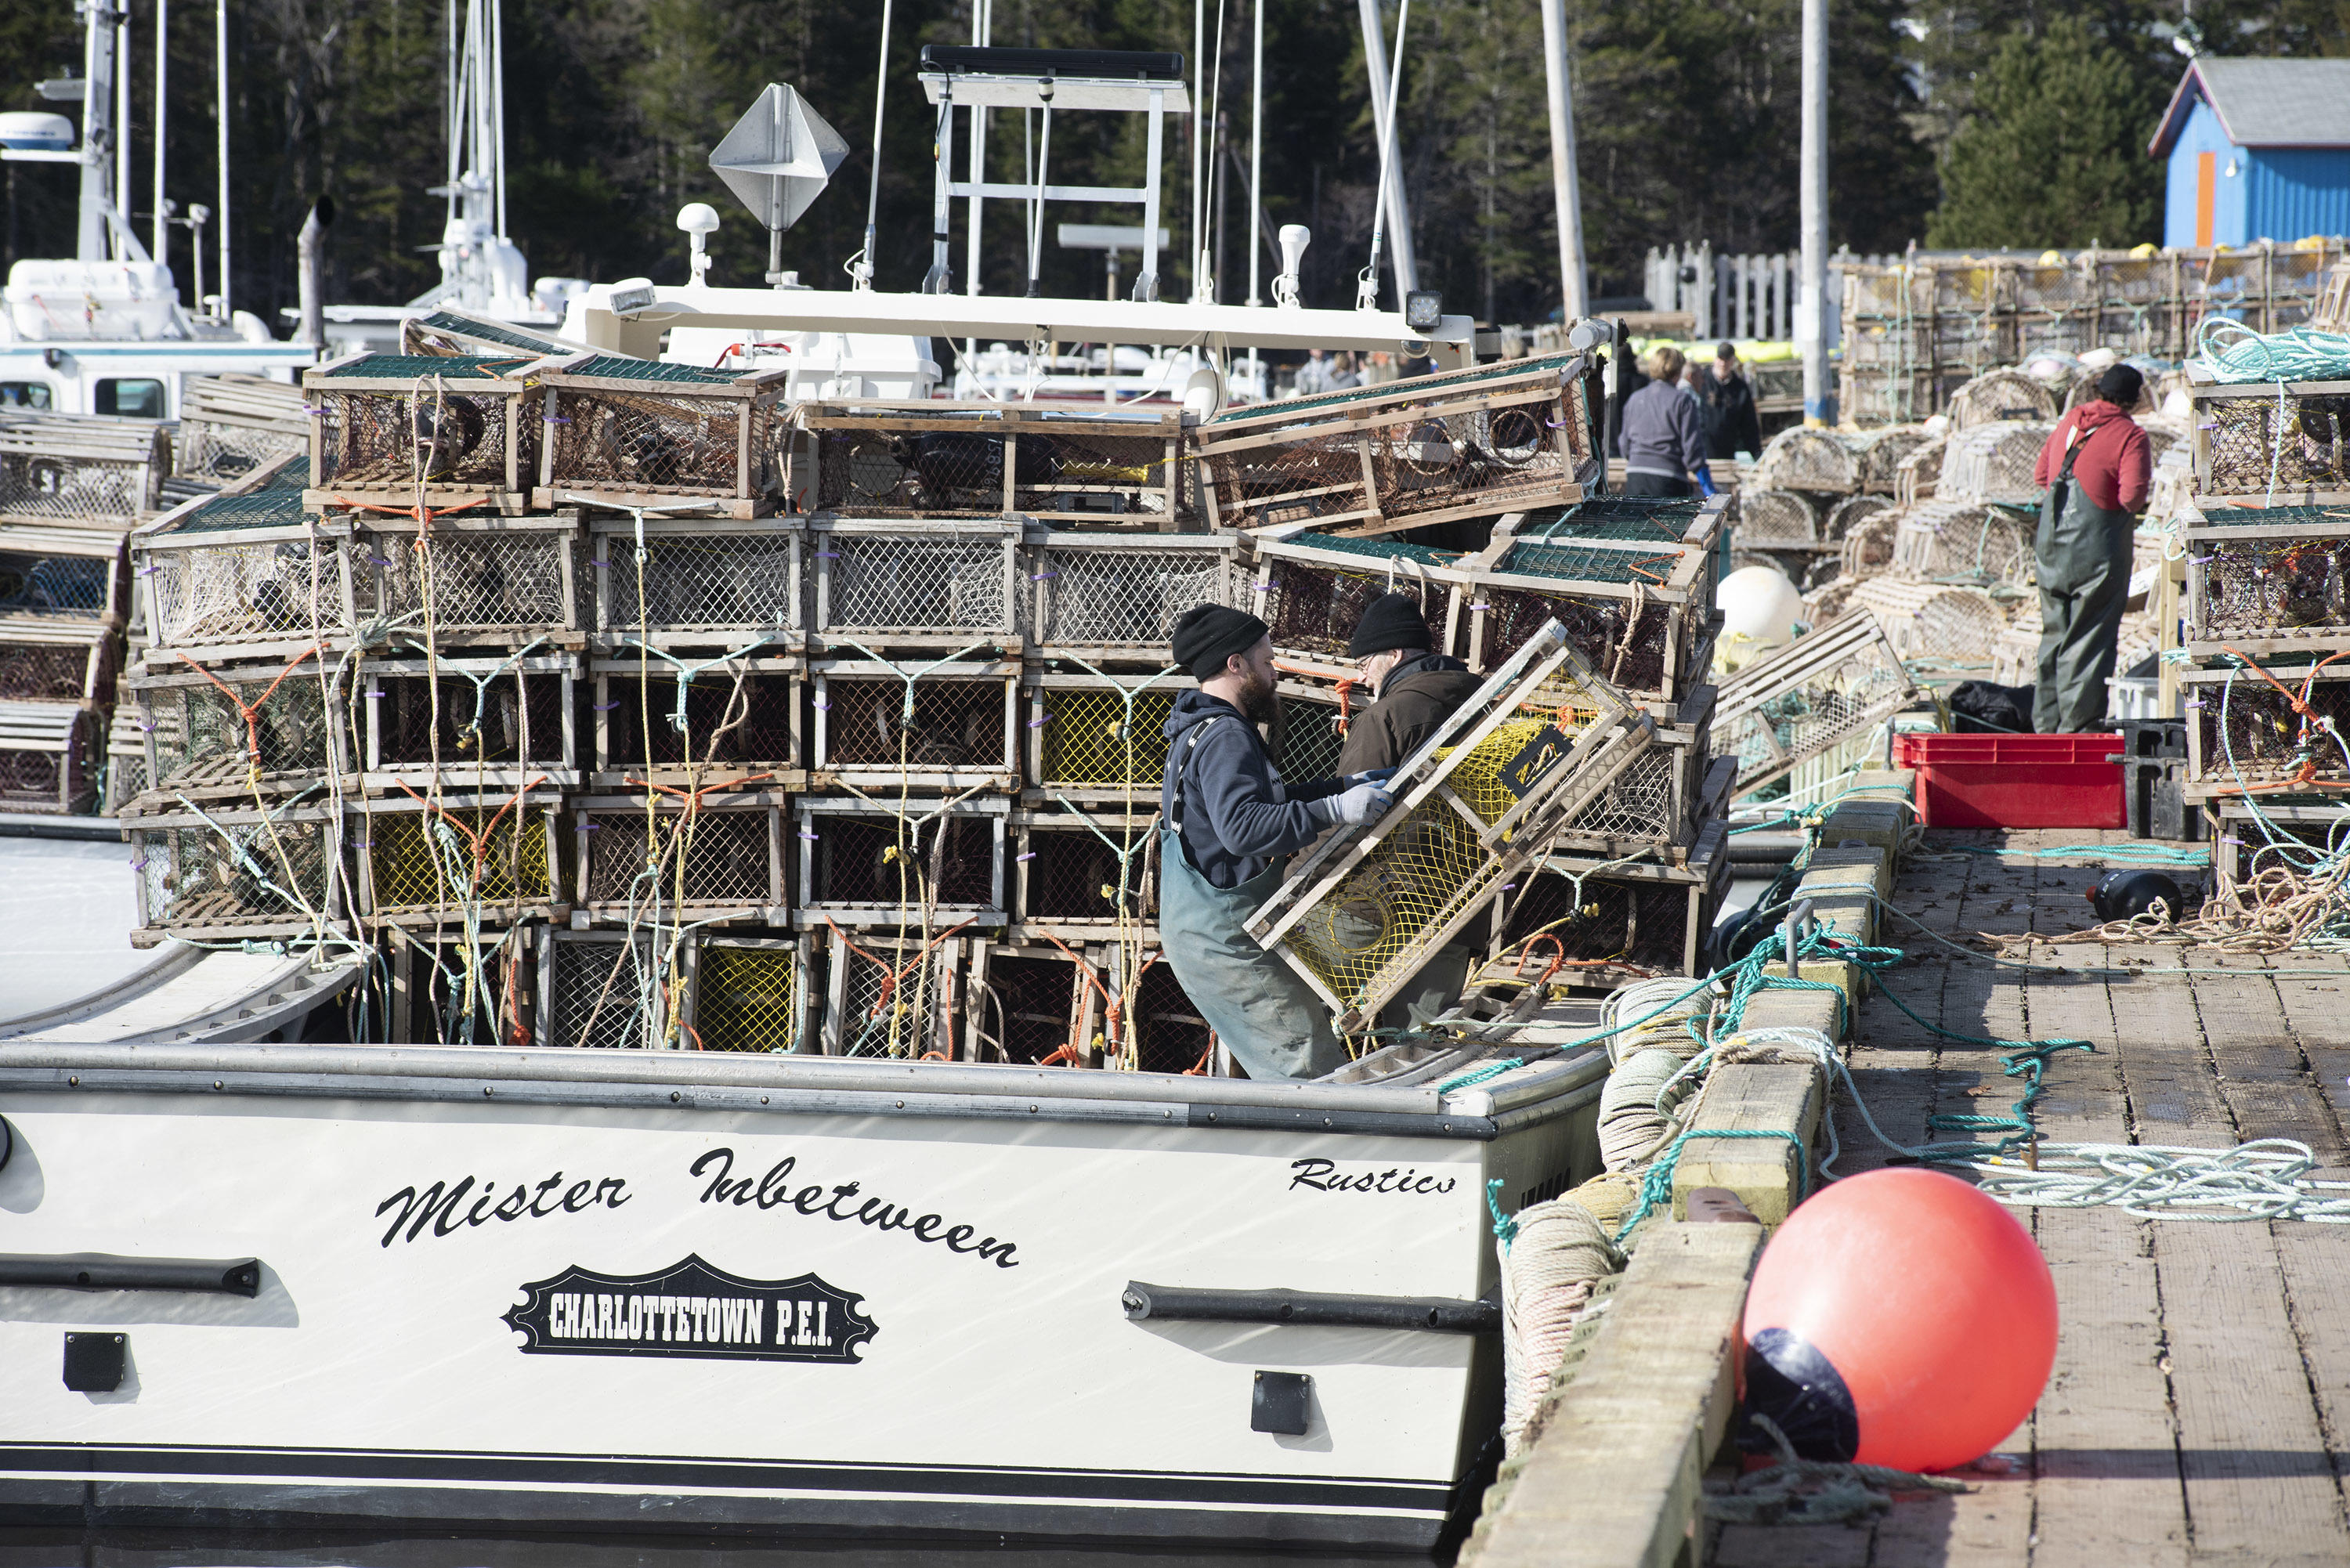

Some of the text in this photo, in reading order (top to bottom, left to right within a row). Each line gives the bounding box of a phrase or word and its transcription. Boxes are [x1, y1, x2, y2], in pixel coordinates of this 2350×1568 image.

[1289, 1158, 1456, 1194] Rustico
[375, 1147, 1020, 1269] Mister Inbetween
[549, 1292, 833, 1347] CHARLOTTETOWN P.E.I.
